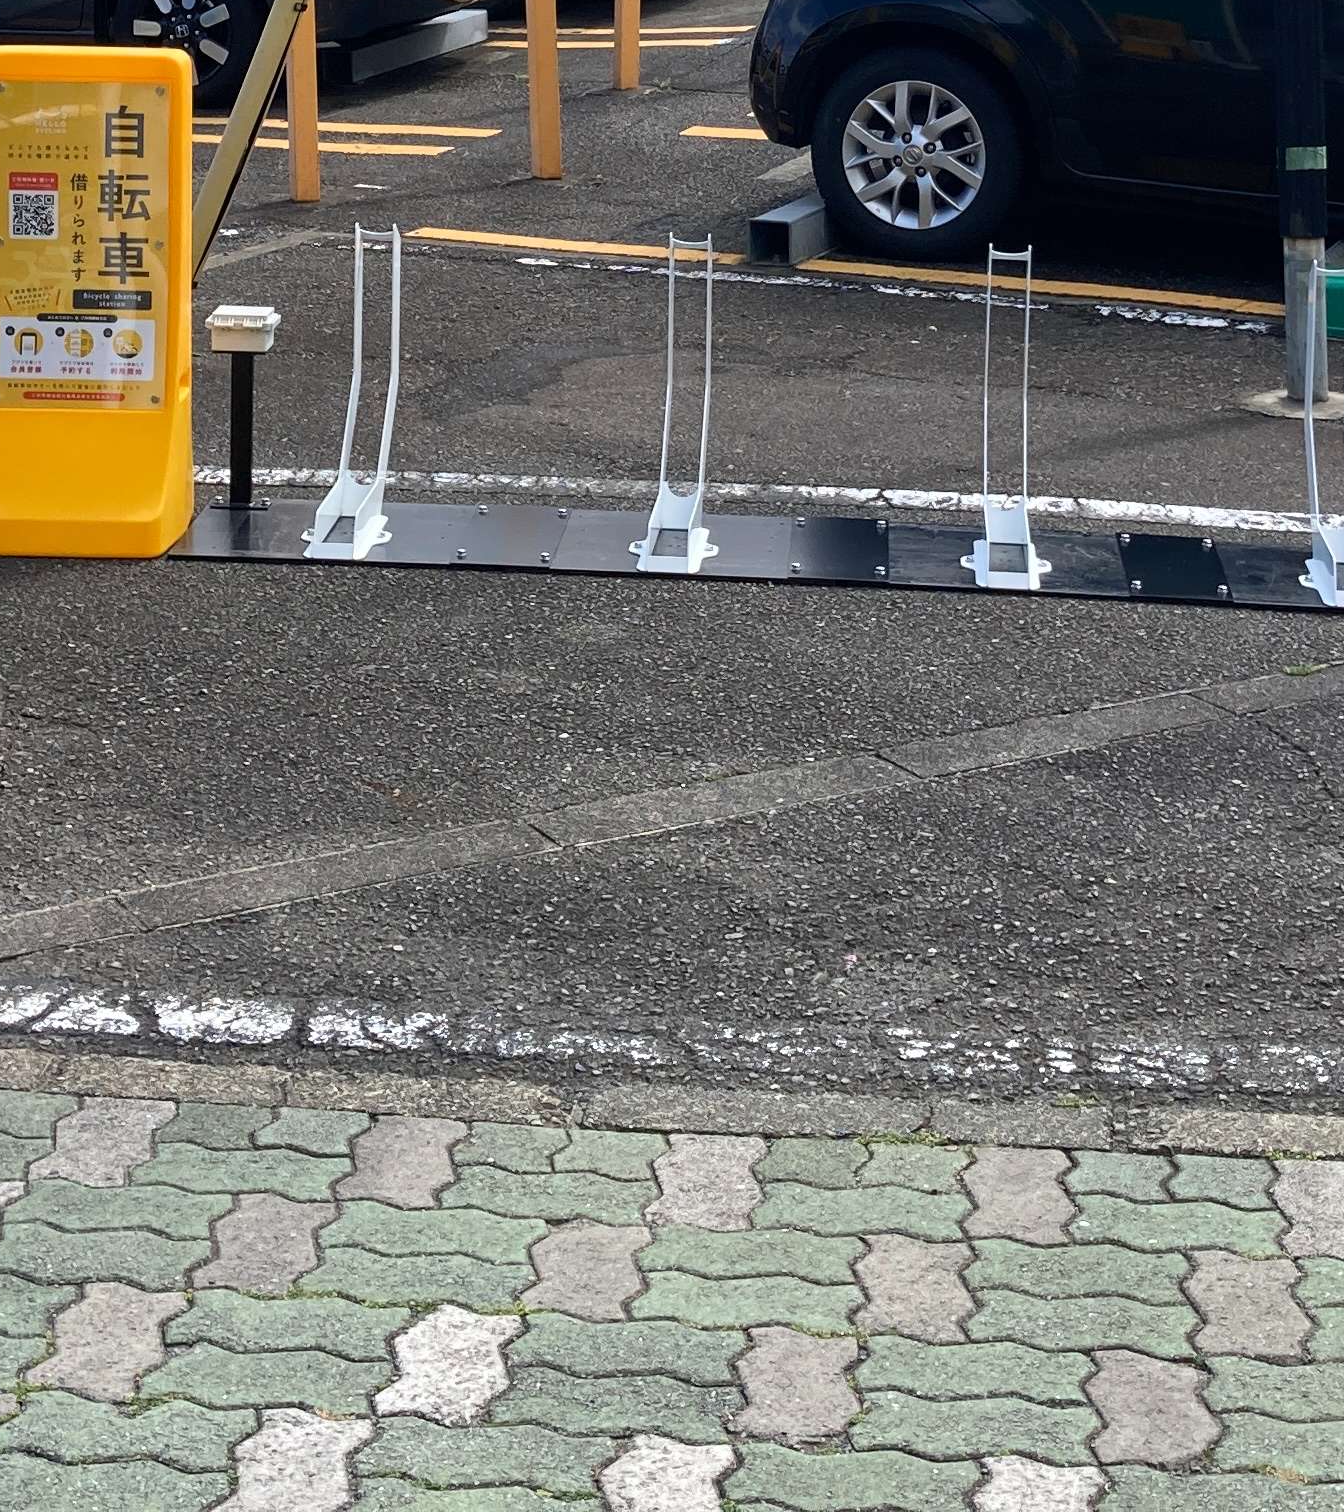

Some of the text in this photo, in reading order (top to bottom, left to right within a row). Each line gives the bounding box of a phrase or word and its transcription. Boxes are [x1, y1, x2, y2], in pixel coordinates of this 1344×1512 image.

[70, 173, 88, 282] 借りられます
[97, 105, 151, 285] 自転車
[83, 291, 142, 301] Bicycle sharing
